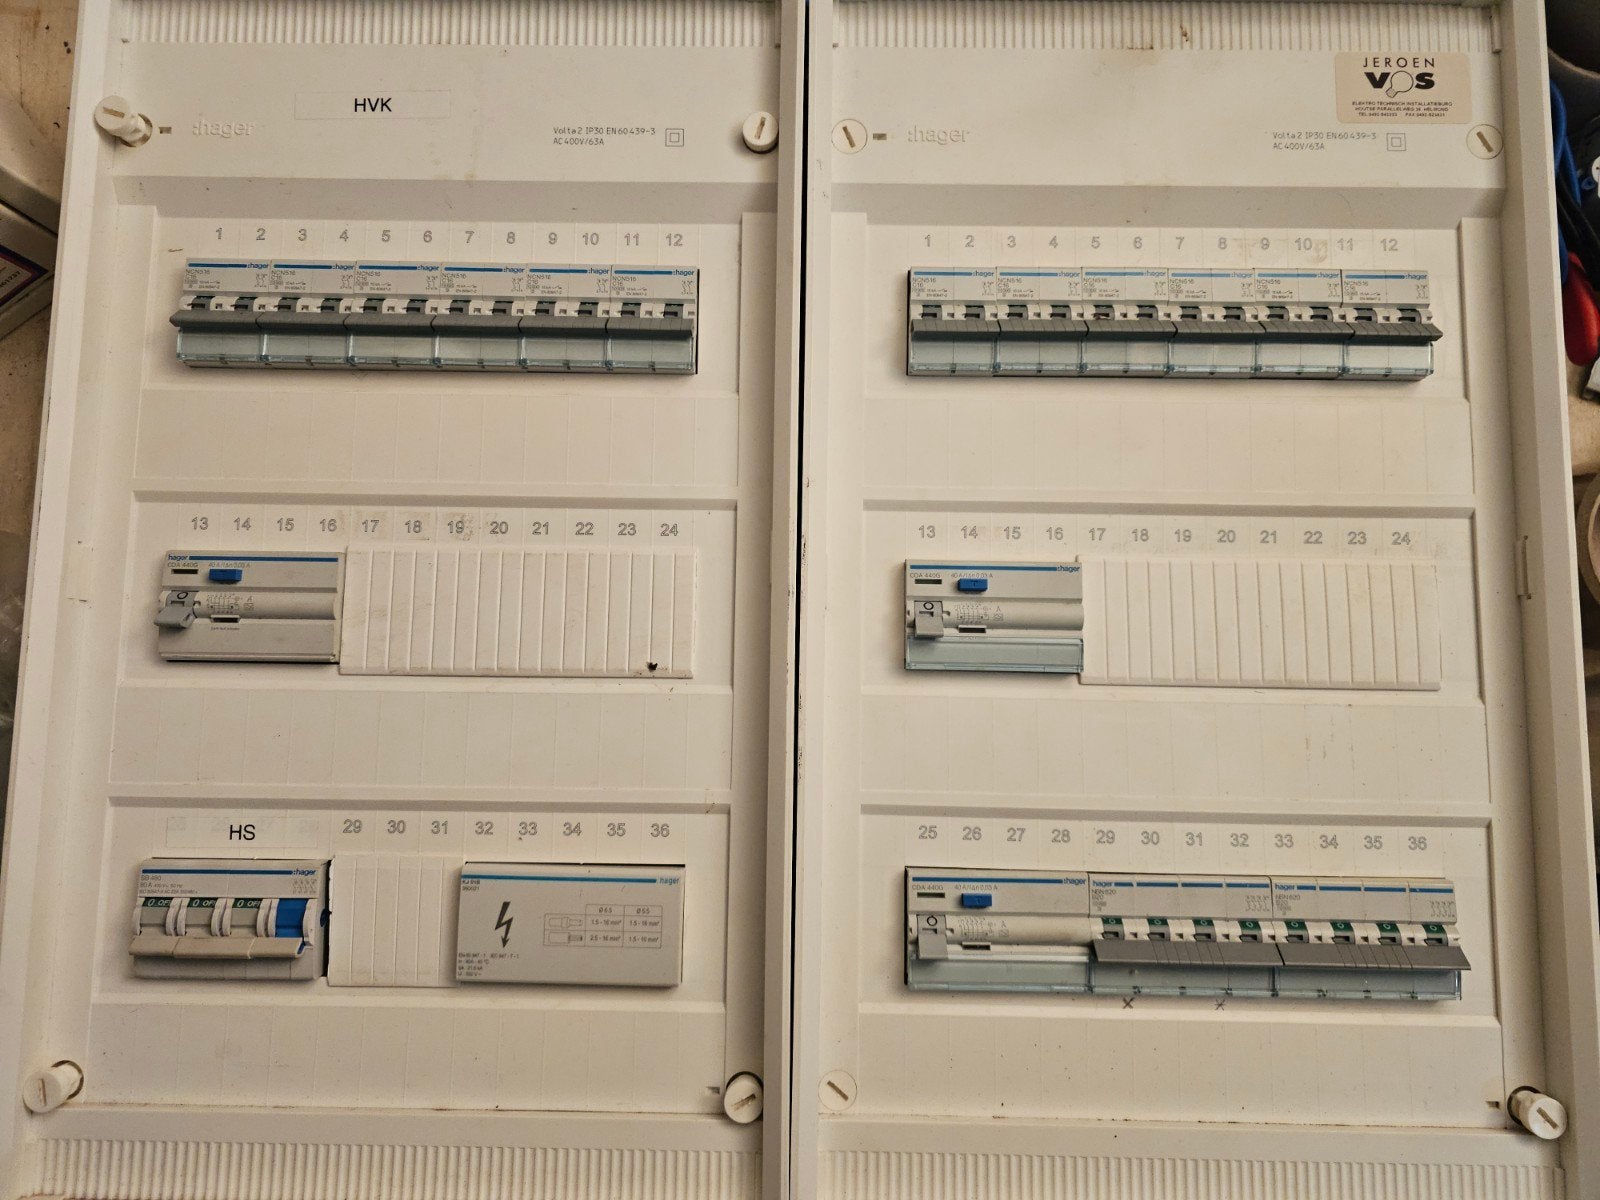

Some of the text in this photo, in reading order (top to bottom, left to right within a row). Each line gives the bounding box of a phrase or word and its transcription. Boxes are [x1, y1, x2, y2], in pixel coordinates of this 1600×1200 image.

[1363, 57, 1435, 68] JEROEN
[354, 98, 393, 112] HVK
[215, 228, 683, 247] 1 2 3 4 5 6 7 8 9 10 11 12
[924, 234, 1398, 252] 1 2 3 4 5 6 7 8 9 10 11 12
[191, 517, 679, 537] 13 14 15 16 17 18 19 20 21 22 23 24
[918, 525, 1411, 545] 13 14 15 16 17 18 19 20 21 22 23 24
[229, 824, 256, 840] HS
[343, 819, 670, 838] 29 30 31 32 33 34 35 36
[918, 825, 1427, 851] 25 26 27 28 29 30 31 32 33 34 35 36
